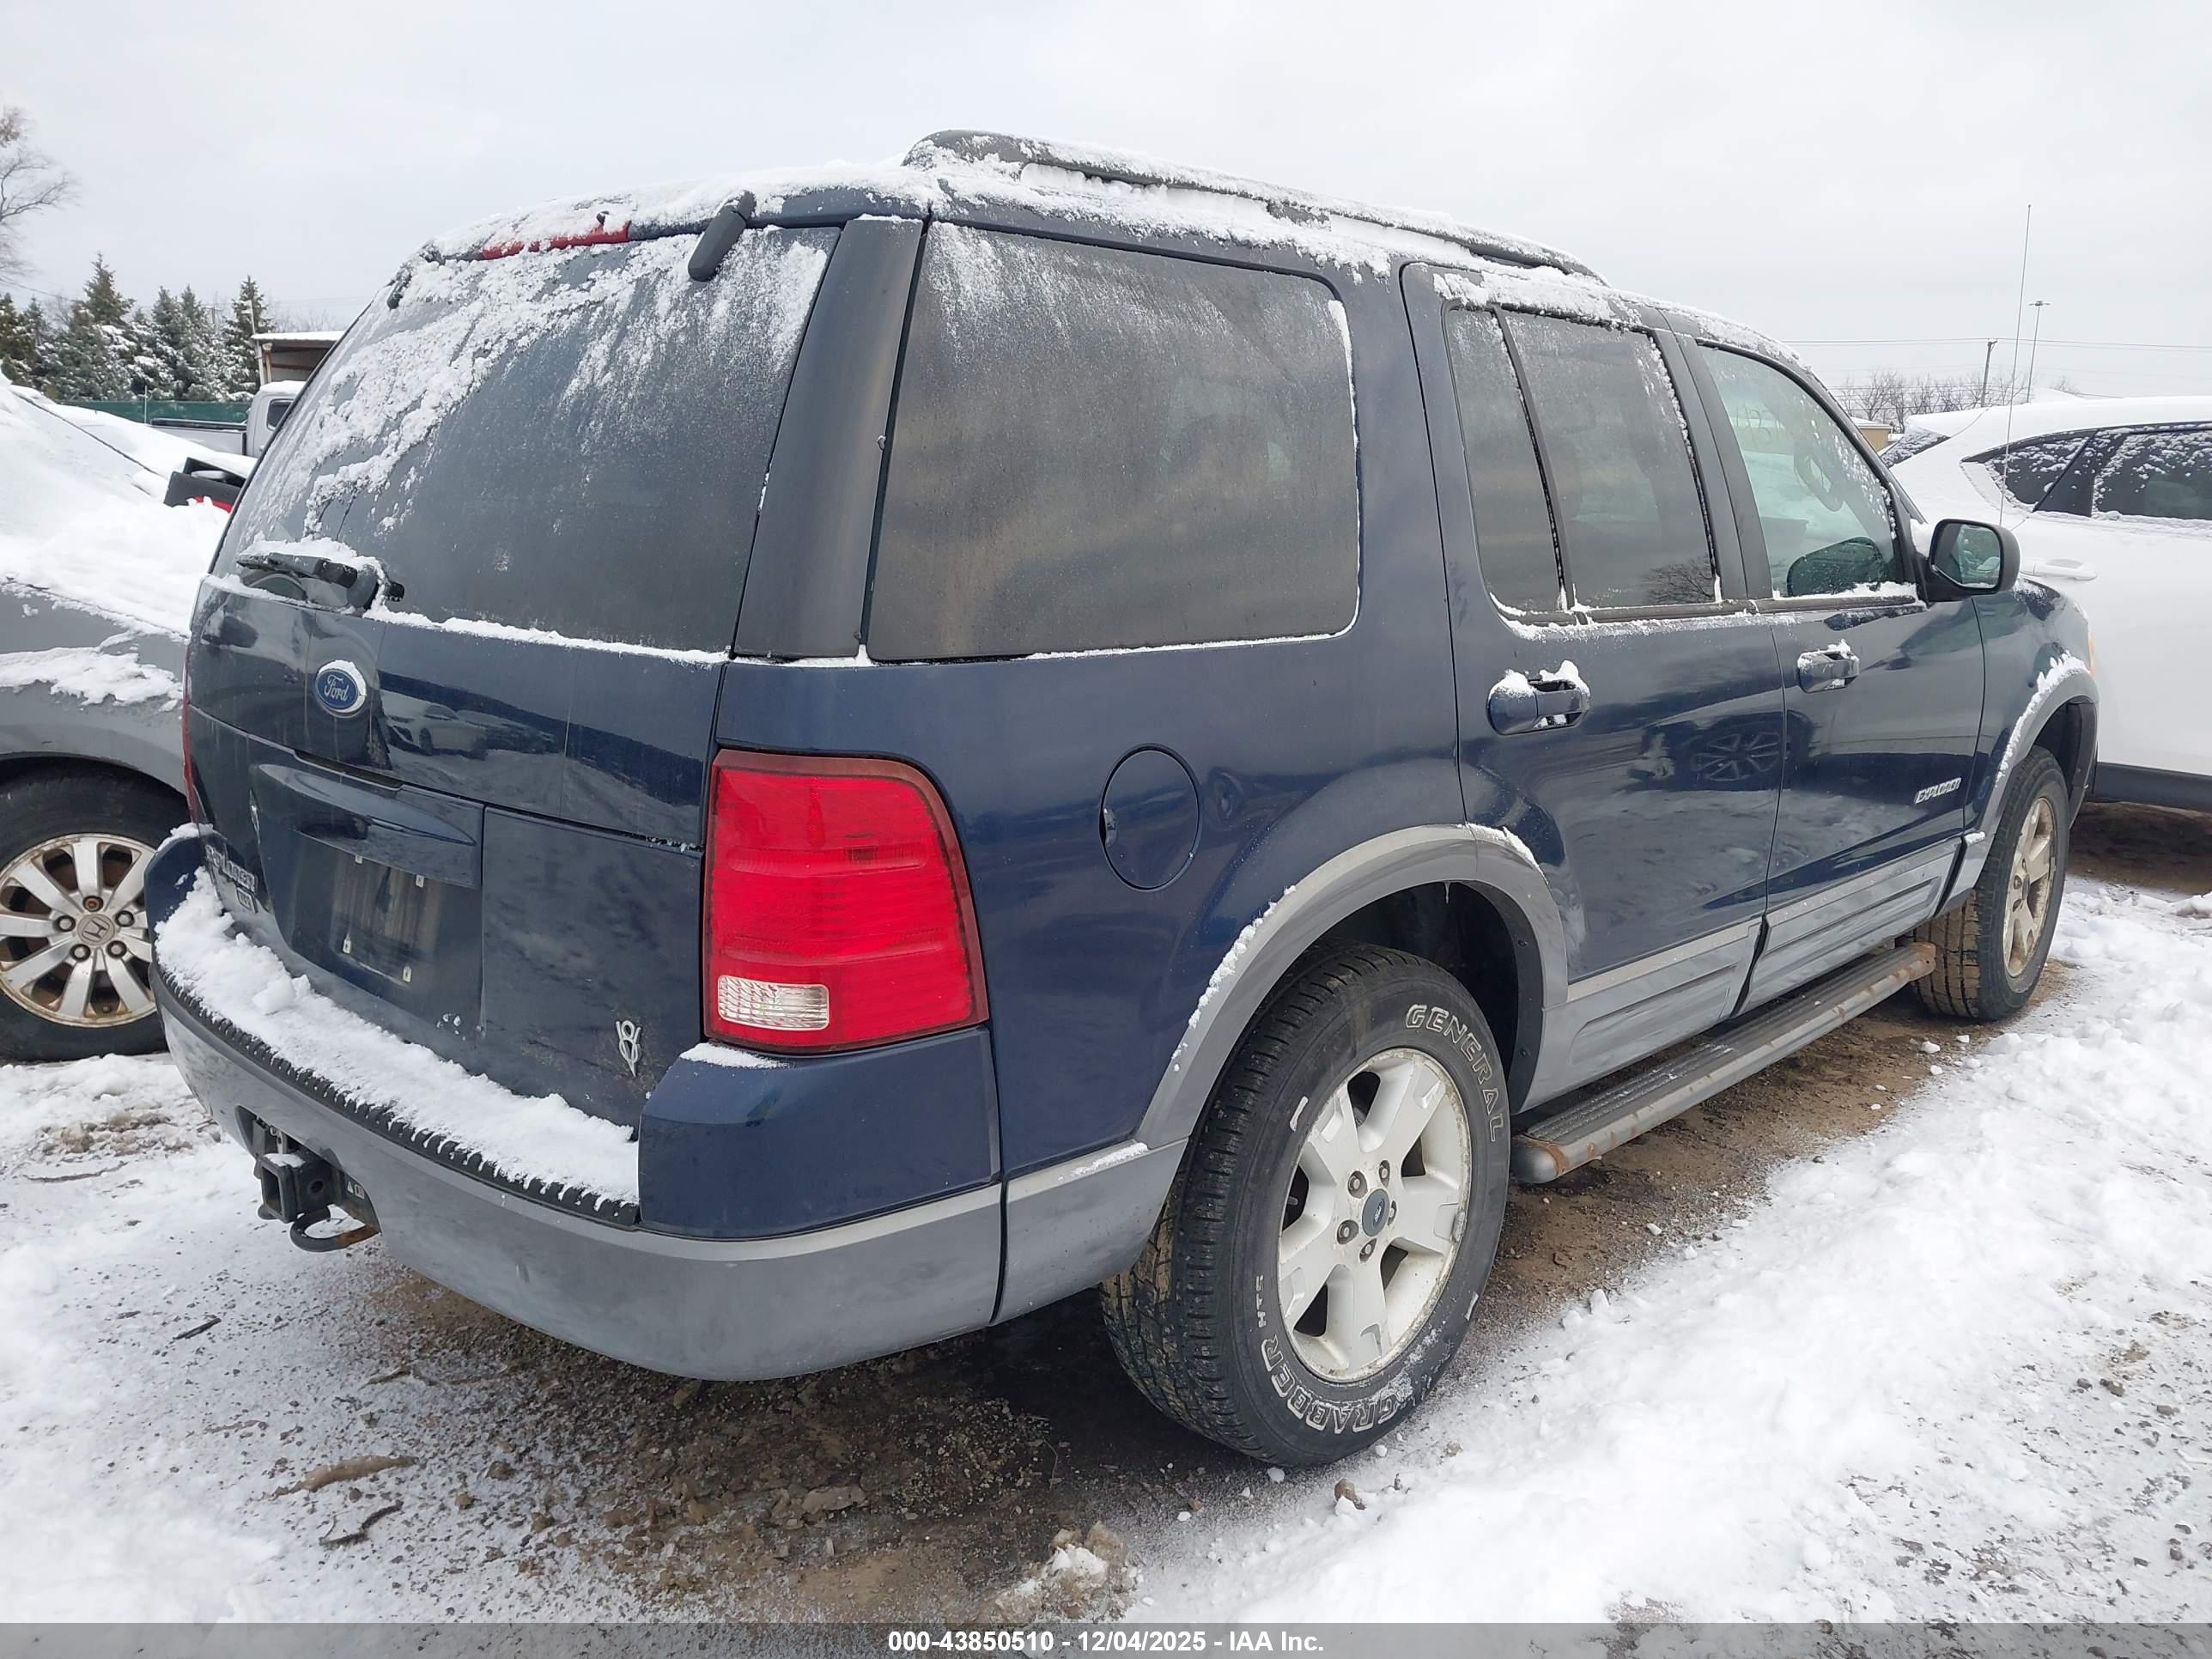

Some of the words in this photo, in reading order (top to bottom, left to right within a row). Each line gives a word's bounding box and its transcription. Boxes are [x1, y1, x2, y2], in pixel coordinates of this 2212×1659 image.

[324, 674, 349, 701] Ford
[1406, 1004, 1504, 1142] GENERAL
[1261, 1334, 1400, 1434] GRABBER
